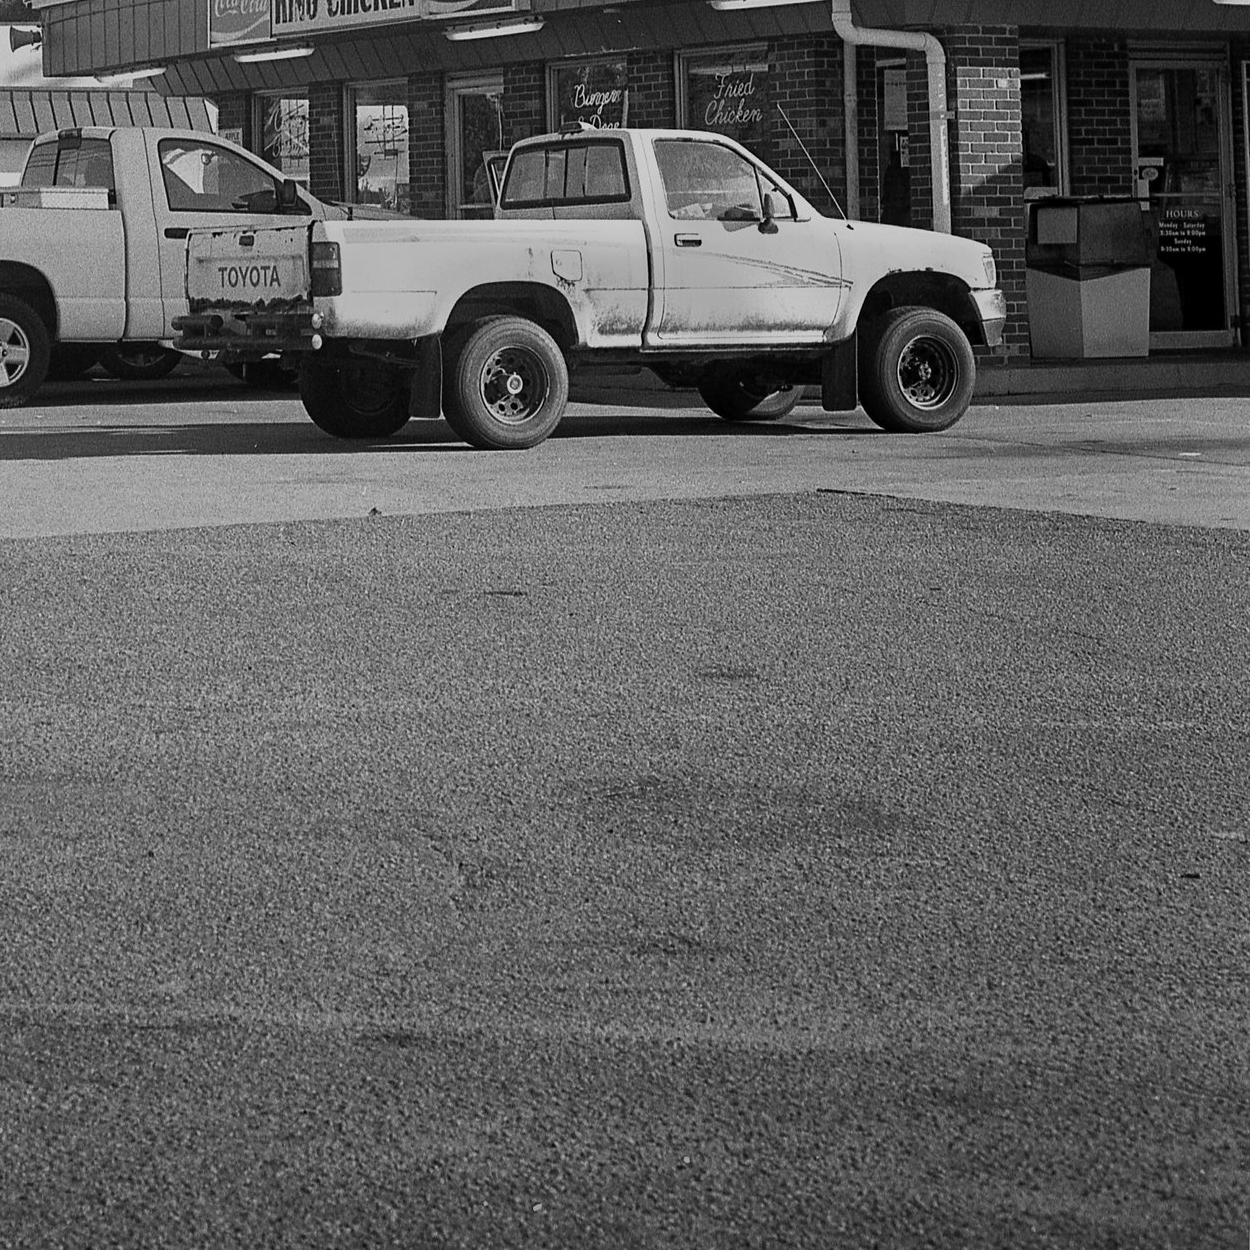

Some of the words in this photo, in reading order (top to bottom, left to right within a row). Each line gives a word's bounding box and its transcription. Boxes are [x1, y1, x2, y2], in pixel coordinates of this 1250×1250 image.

[713, 72, 755, 100] Fried
[704, 98, 763, 126] Chicken
[1159, 221, 1178, 229] Monday
[1166, 210, 1199, 218] HOURS
[218, 265, 281, 288] TOYOTA
